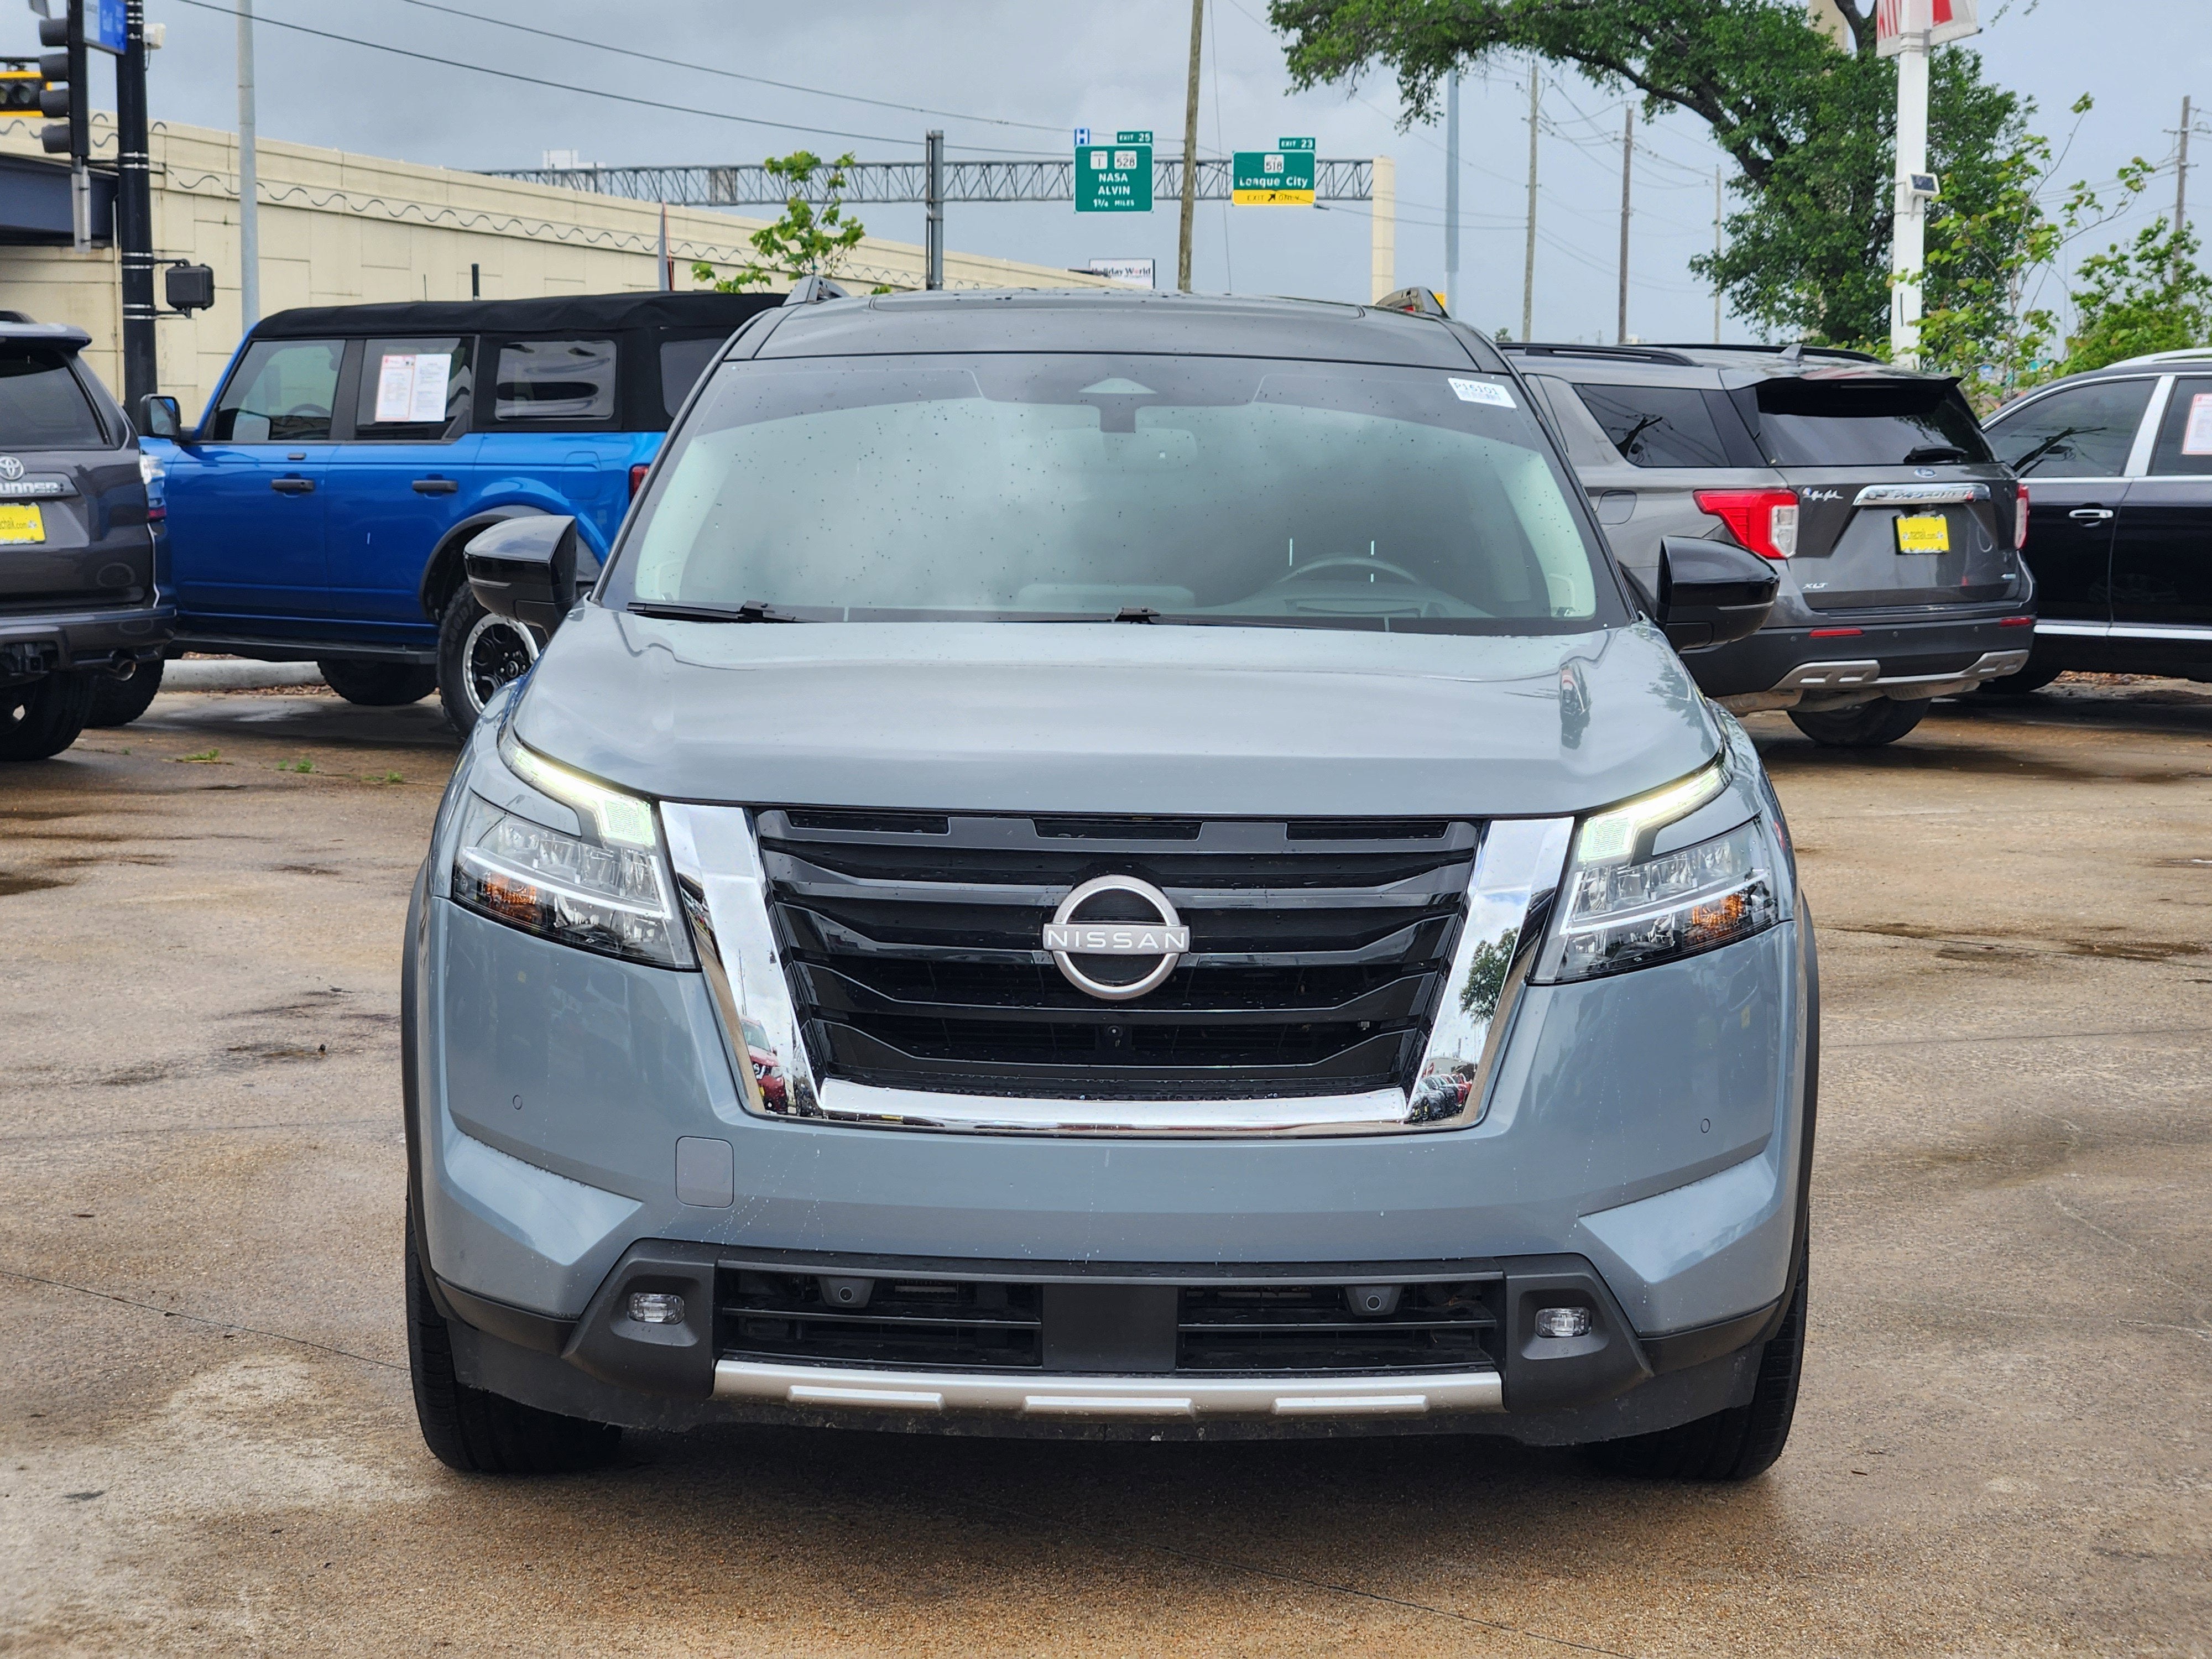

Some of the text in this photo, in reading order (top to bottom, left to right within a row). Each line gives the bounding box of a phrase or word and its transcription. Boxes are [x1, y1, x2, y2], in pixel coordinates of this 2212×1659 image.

[1301, 139, 1313, 148] 23
[1117, 158, 1135, 167] 528
[1266, 161, 1283, 171] 518
[1098, 173, 1129, 182] NASA
[1286, 176, 1308, 189] City
[1098, 185, 1131, 196] ALVIN
[1047, 929, 1185, 949] NISSAN
